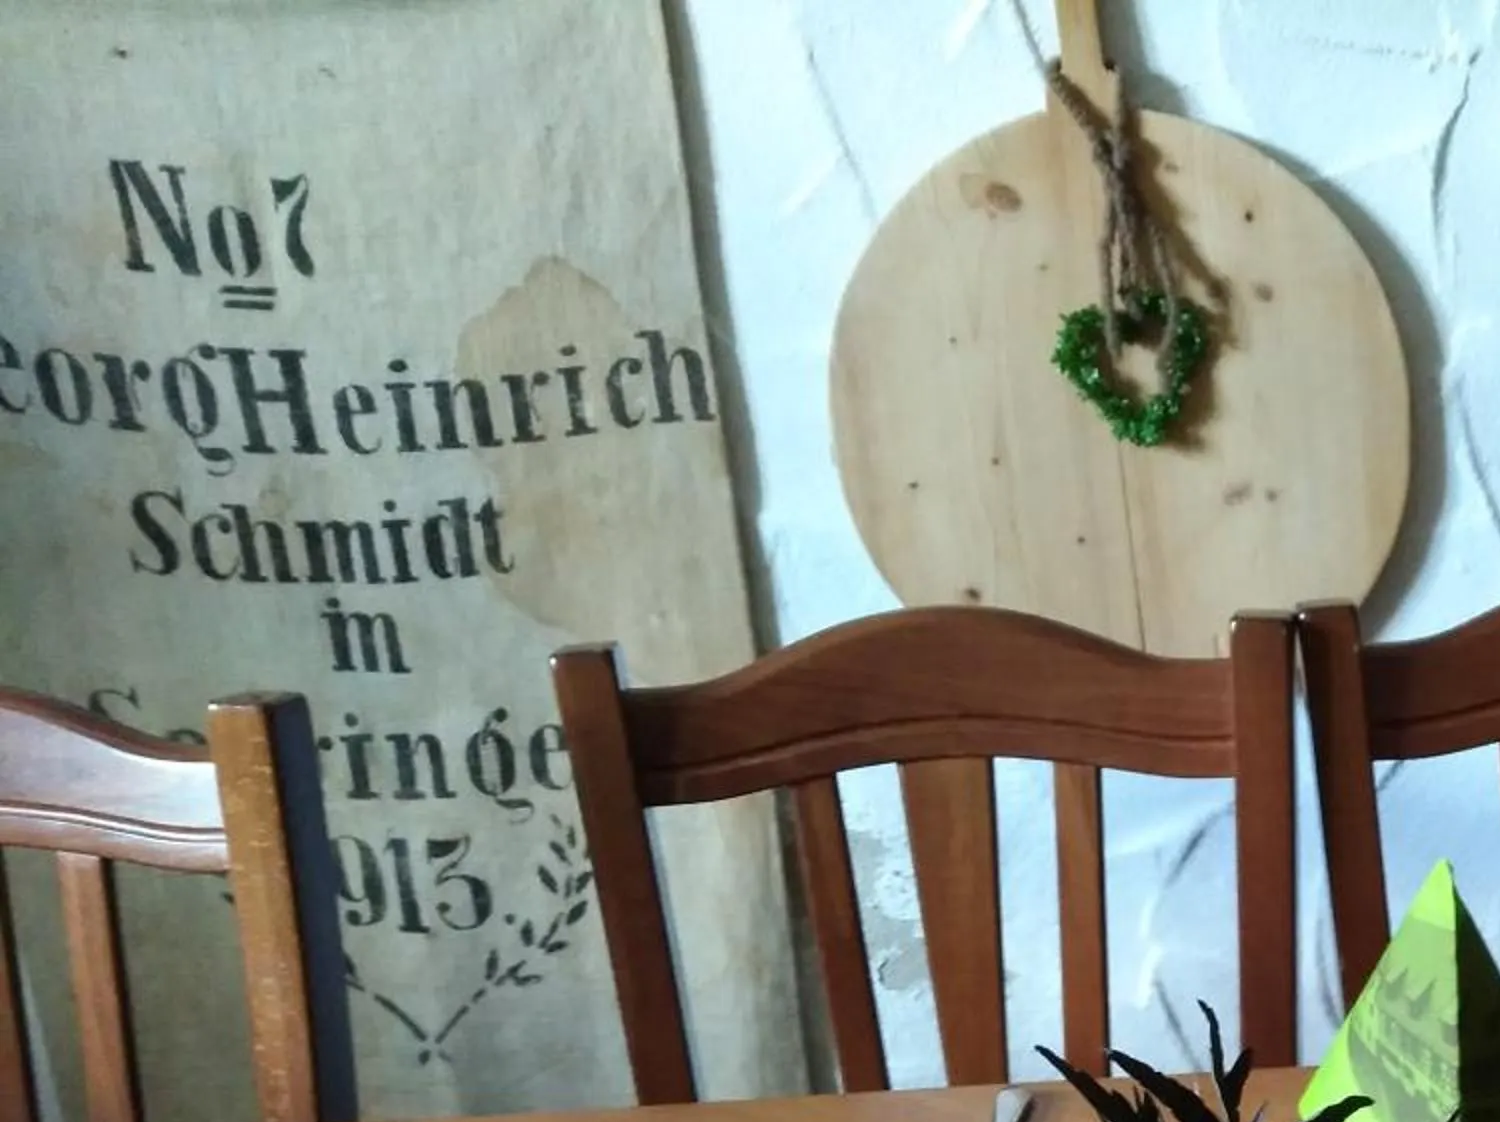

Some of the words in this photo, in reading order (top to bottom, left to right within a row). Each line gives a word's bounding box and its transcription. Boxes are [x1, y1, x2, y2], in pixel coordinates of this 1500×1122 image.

[129, 489, 515, 585] Schmidt
[321, 597, 412, 674] in
[334, 832, 494, 935] 913
